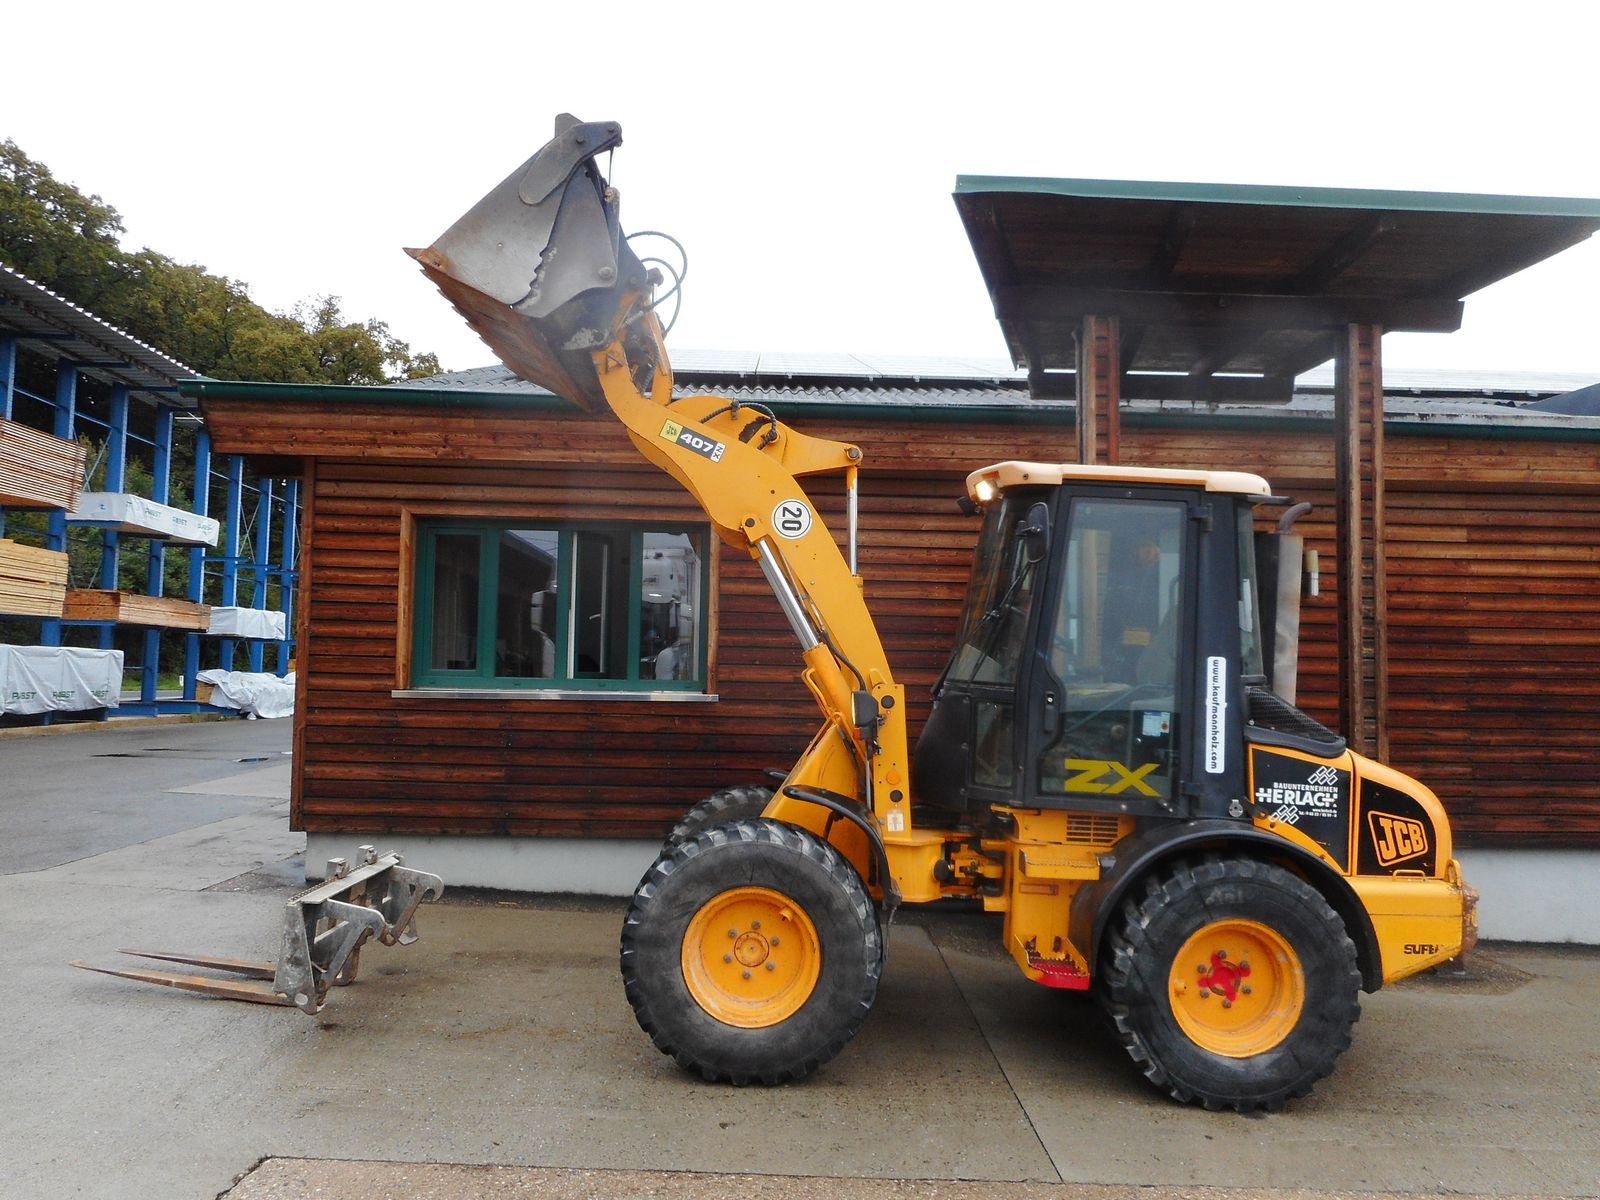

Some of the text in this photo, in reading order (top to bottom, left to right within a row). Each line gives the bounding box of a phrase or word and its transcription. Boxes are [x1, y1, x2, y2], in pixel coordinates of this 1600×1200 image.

[680, 434, 714, 452] 407
[782, 508, 802, 531] 20
[1211, 660, 1220, 769] www.kaufmannholz.com
[1064, 759, 1161, 797] ZX
[1273, 782, 1338, 793] BAUUNTERNEHMEN
[1256, 788, 1338, 807] HERLACH
[1379, 818, 1427, 861] JCB
